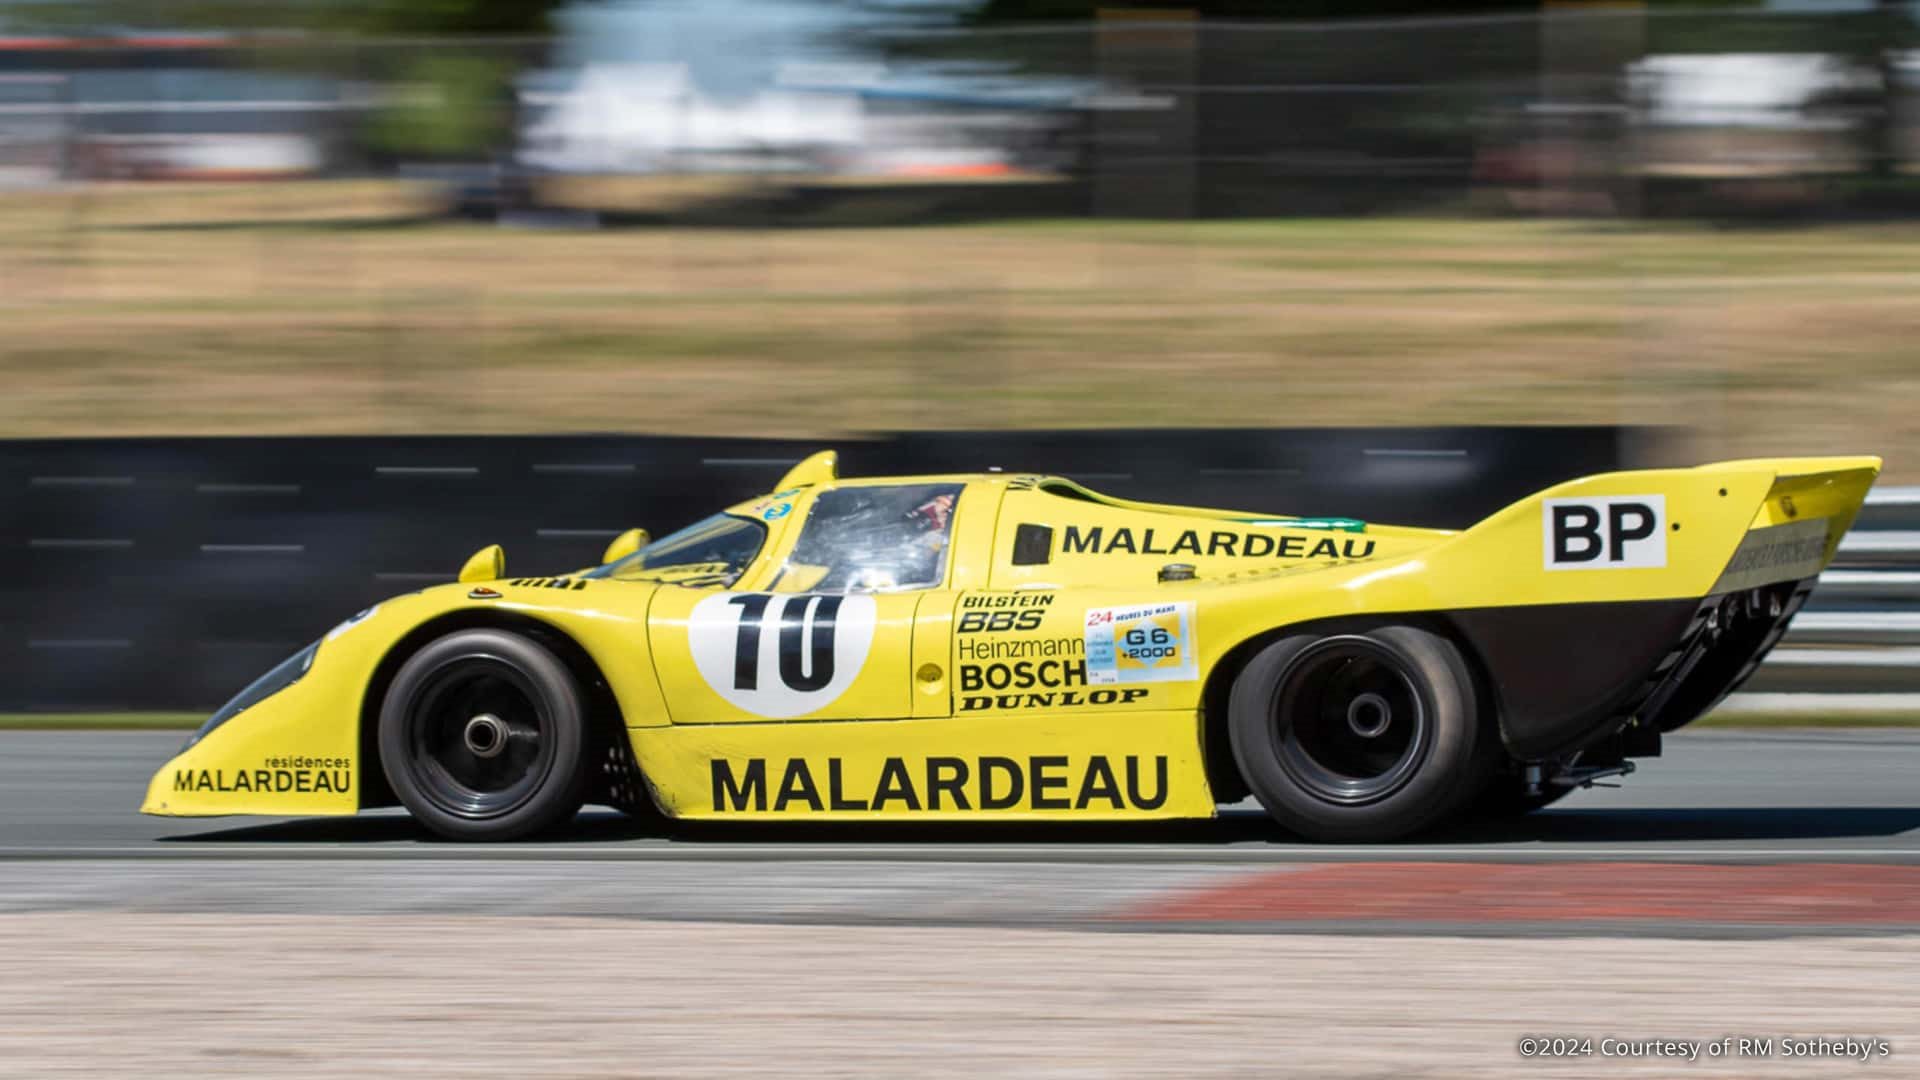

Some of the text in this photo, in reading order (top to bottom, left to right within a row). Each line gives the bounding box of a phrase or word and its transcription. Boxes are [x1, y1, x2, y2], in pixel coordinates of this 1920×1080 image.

[1061, 525, 1376, 560] MALARDEAU
[1552, 502, 1656, 564] BP
[963, 592, 1054, 607] BILSTEIN
[957, 609, 1045, 634] BBS
[1087, 611, 1114, 626] 24
[1115, 612, 1142, 622] HEURES
[1143, 609, 1154, 618] DU
[728, 594, 845, 693] 10
[959, 636, 1086, 660] Heinzmann
[1122, 647, 1176, 659] +2000
[961, 660, 1088, 691] BOSCH
[960, 689, 1149, 711] DUNLOP
[174, 769, 351, 793] MALARDEAU
[710, 756, 1170, 812] MALARDEAU
